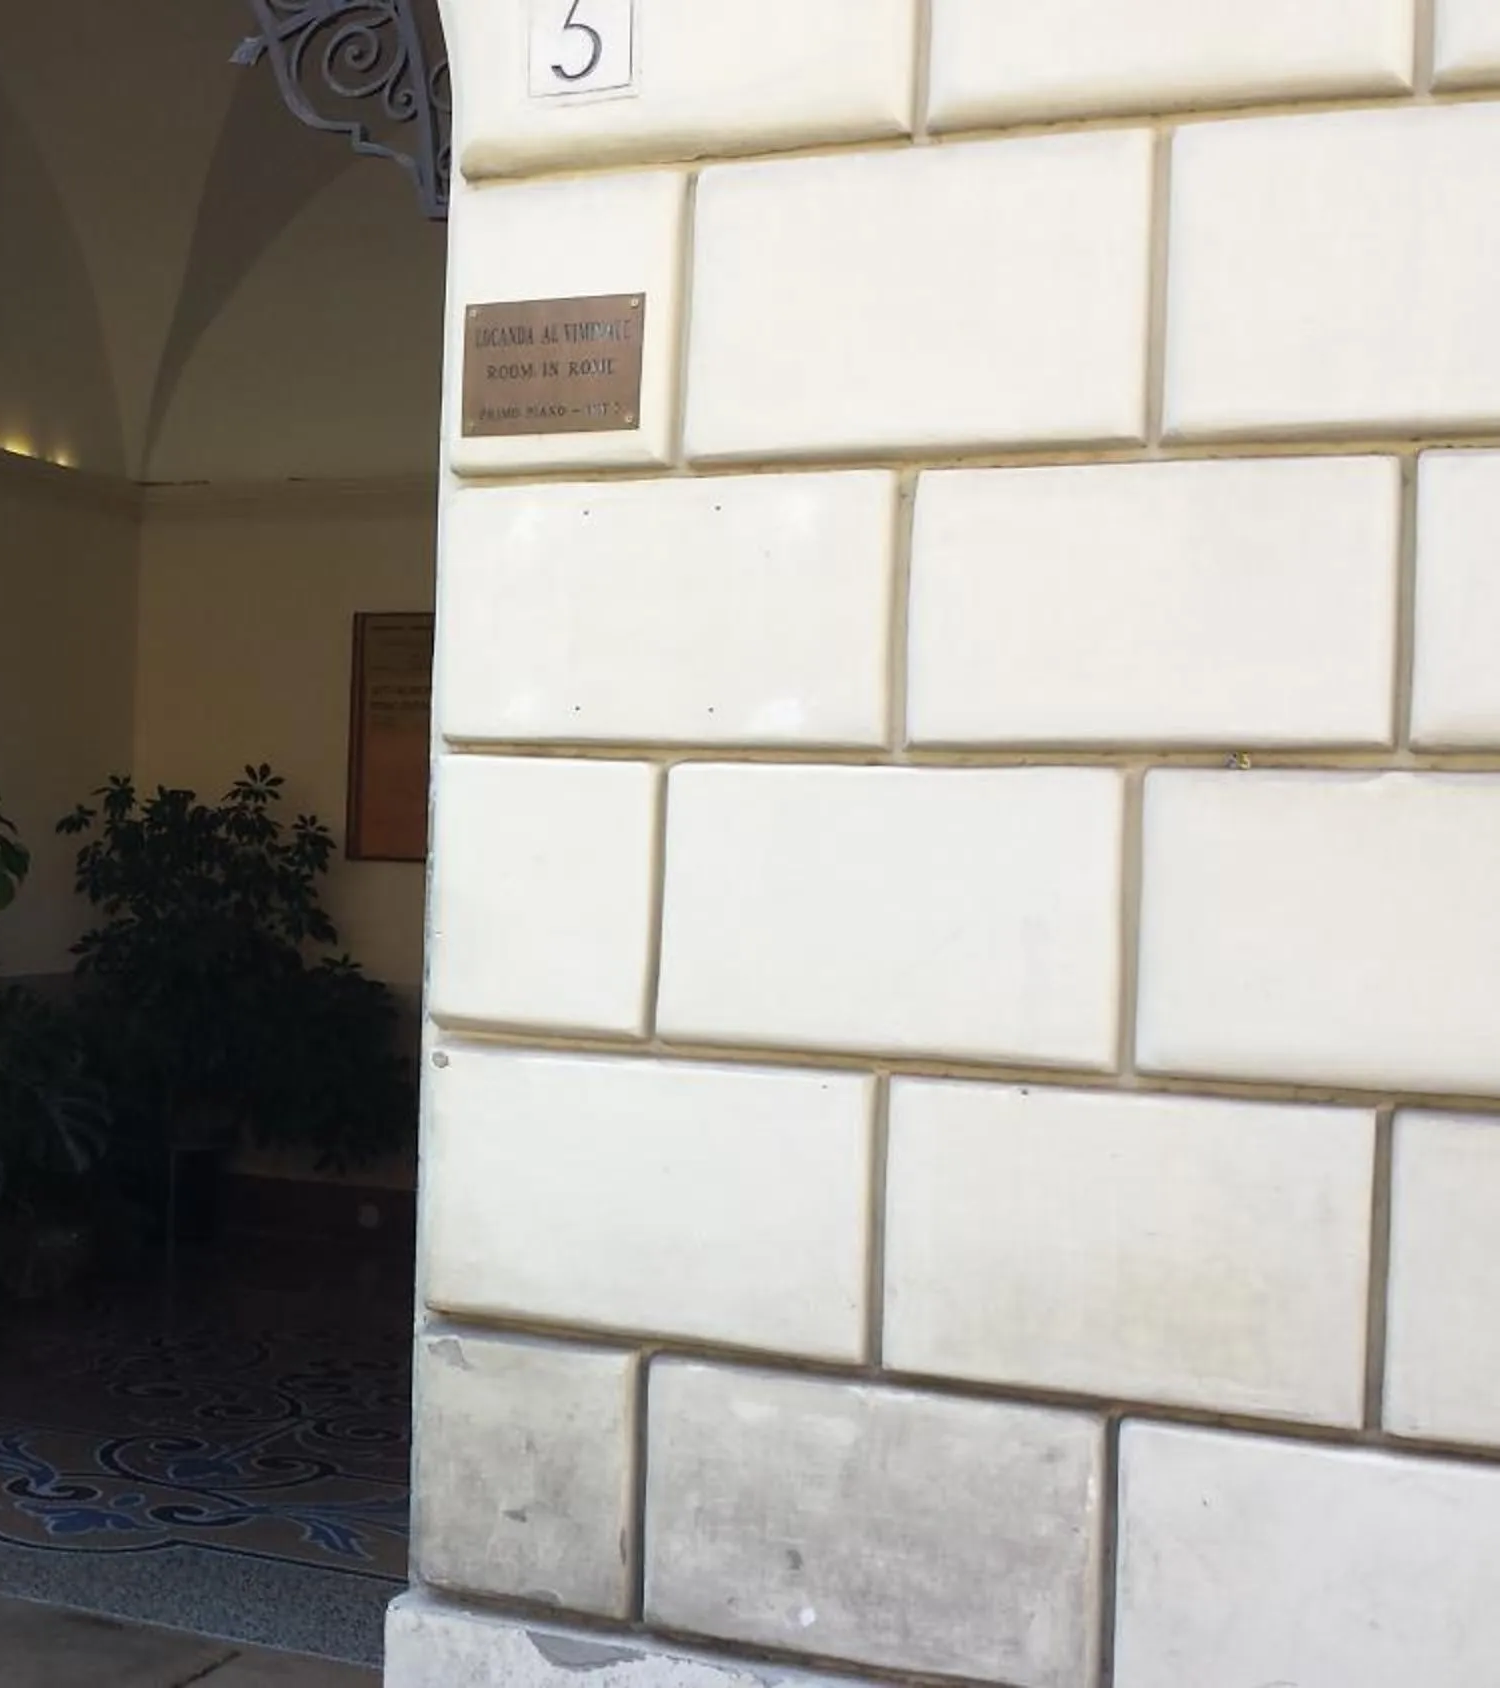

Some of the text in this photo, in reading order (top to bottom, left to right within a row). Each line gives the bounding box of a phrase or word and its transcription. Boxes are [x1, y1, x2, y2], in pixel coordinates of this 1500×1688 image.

[475, 324, 534, 348] LOCANDA
[486, 357, 616, 381] ROOM IN ROME
